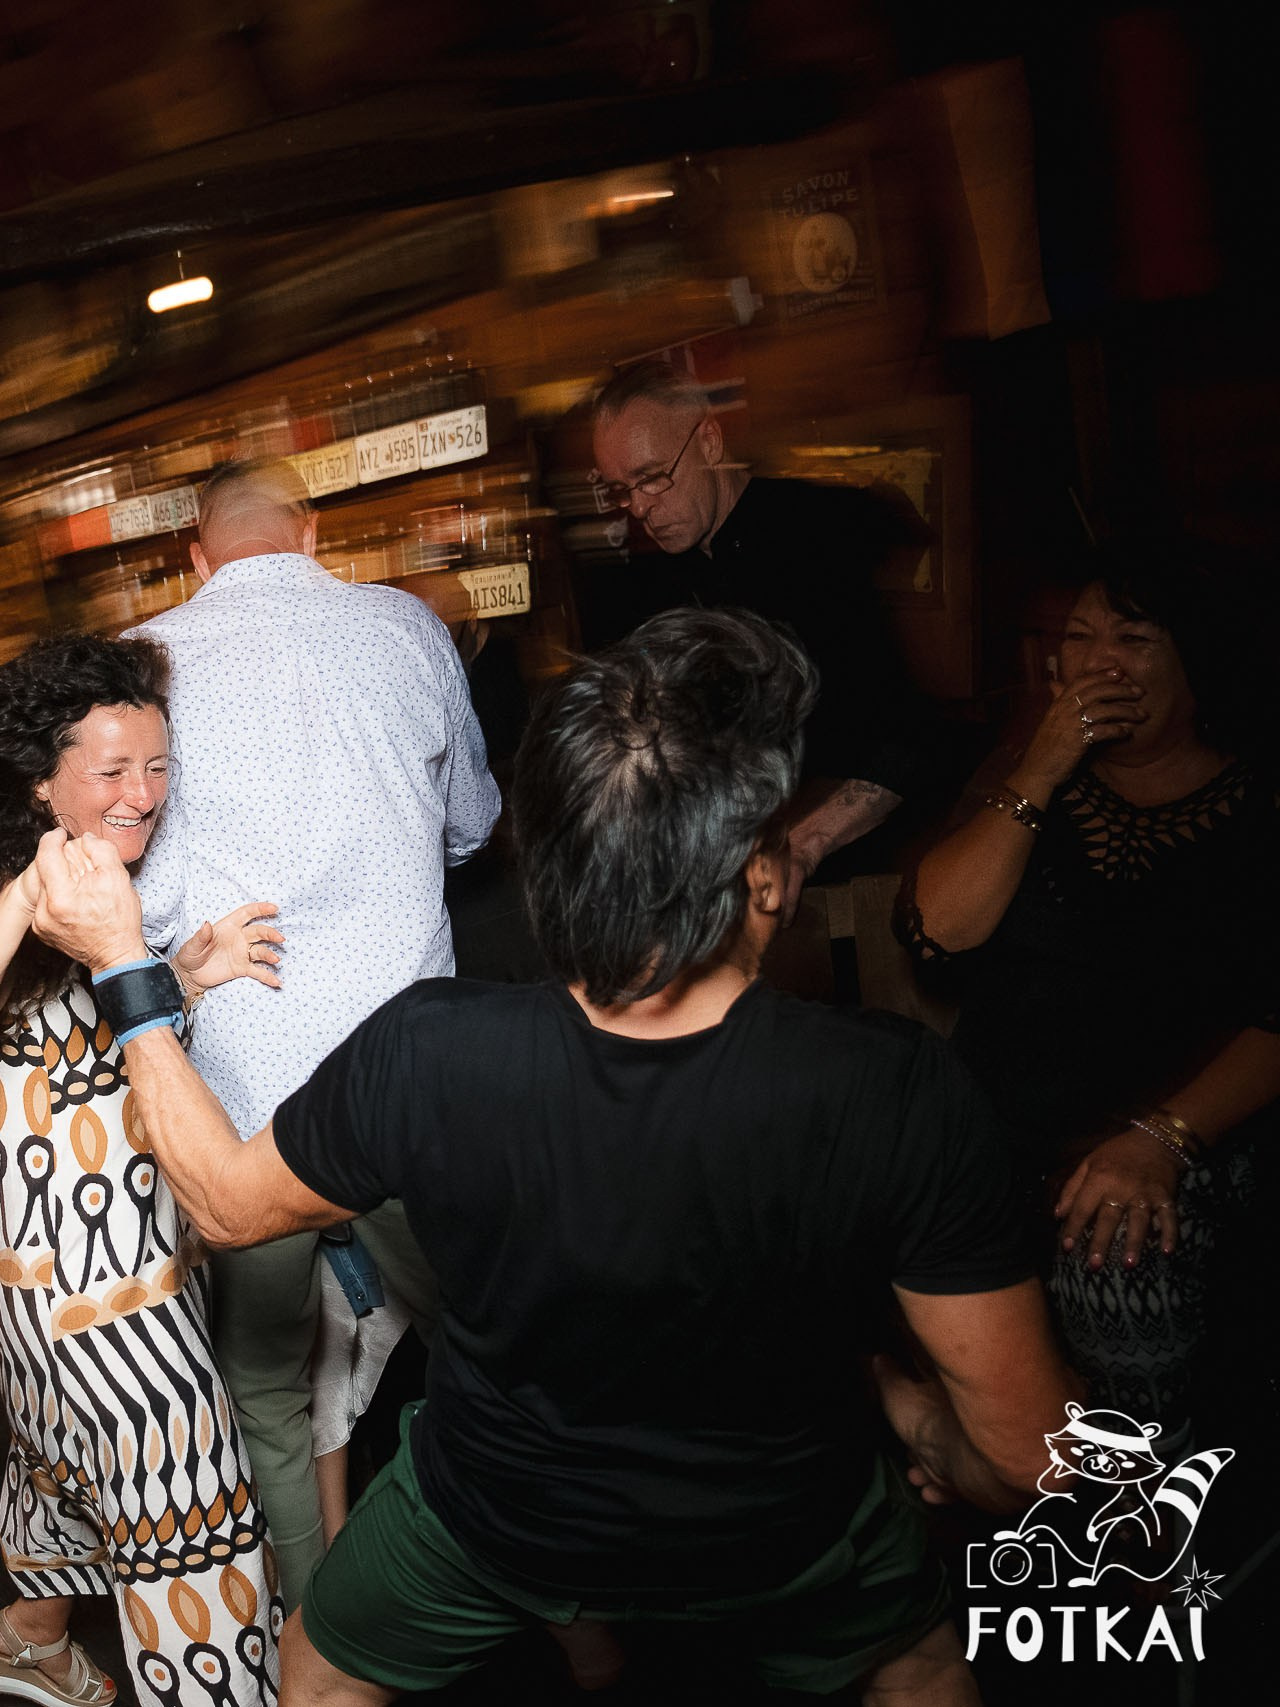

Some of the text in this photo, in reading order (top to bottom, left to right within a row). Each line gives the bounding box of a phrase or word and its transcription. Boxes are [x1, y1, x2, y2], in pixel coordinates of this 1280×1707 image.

[783, 171, 850, 203] SAVON
[456, 422, 483, 450] 526
[360, 447, 380, 473] AYZ
